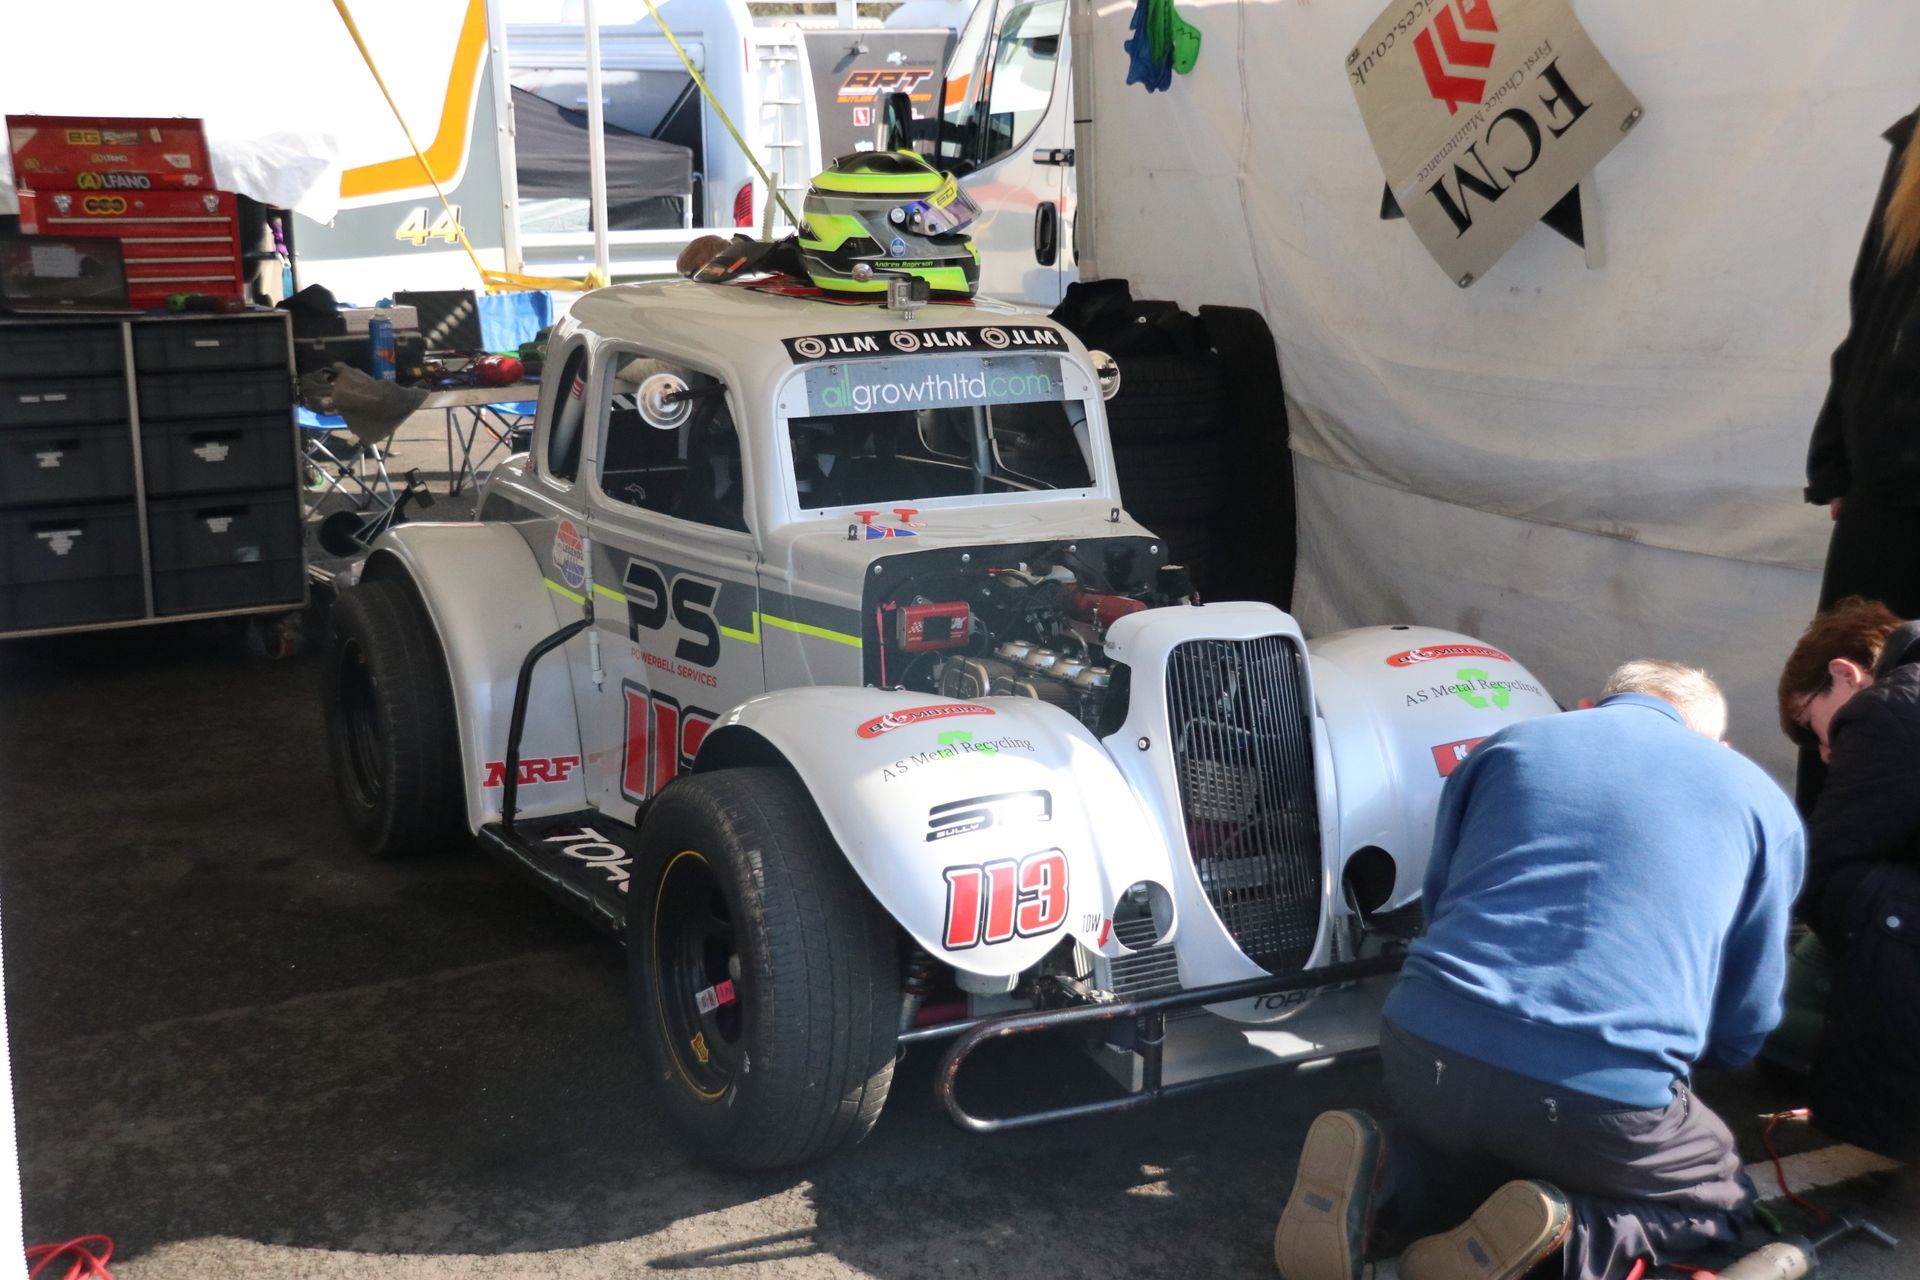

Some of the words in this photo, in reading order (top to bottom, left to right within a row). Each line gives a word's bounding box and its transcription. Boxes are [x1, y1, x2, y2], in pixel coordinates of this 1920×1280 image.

[1351, 0, 1434, 86] ices.co.uk
[1523, 39, 1554, 72] First
[1483, 71, 1525, 113] Choice
[1416, 109, 1487, 183] Maintenance
[1425, 55, 1594, 240] FCM
[829, 336, 880, 354] JLM
[923, 331, 971, 348] JLM
[1012, 329, 1059, 345] JLM
[821, 363, 1052, 412] allgrowthltd.com
[624, 558, 721, 668] PS
[631, 647, 676, 674] POWERBELL
[677, 664, 719, 688] SERVICES
[1430, 679, 1476, 699] Metal
[1477, 678, 1543, 697] Recycling
[909, 744, 959, 767] Metal
[962, 736, 1036, 755] Recycling
[936, 823, 979, 839] BULLY
[942, 846, 1070, 952] 113
[1082, 913, 1101, 933] TOW
